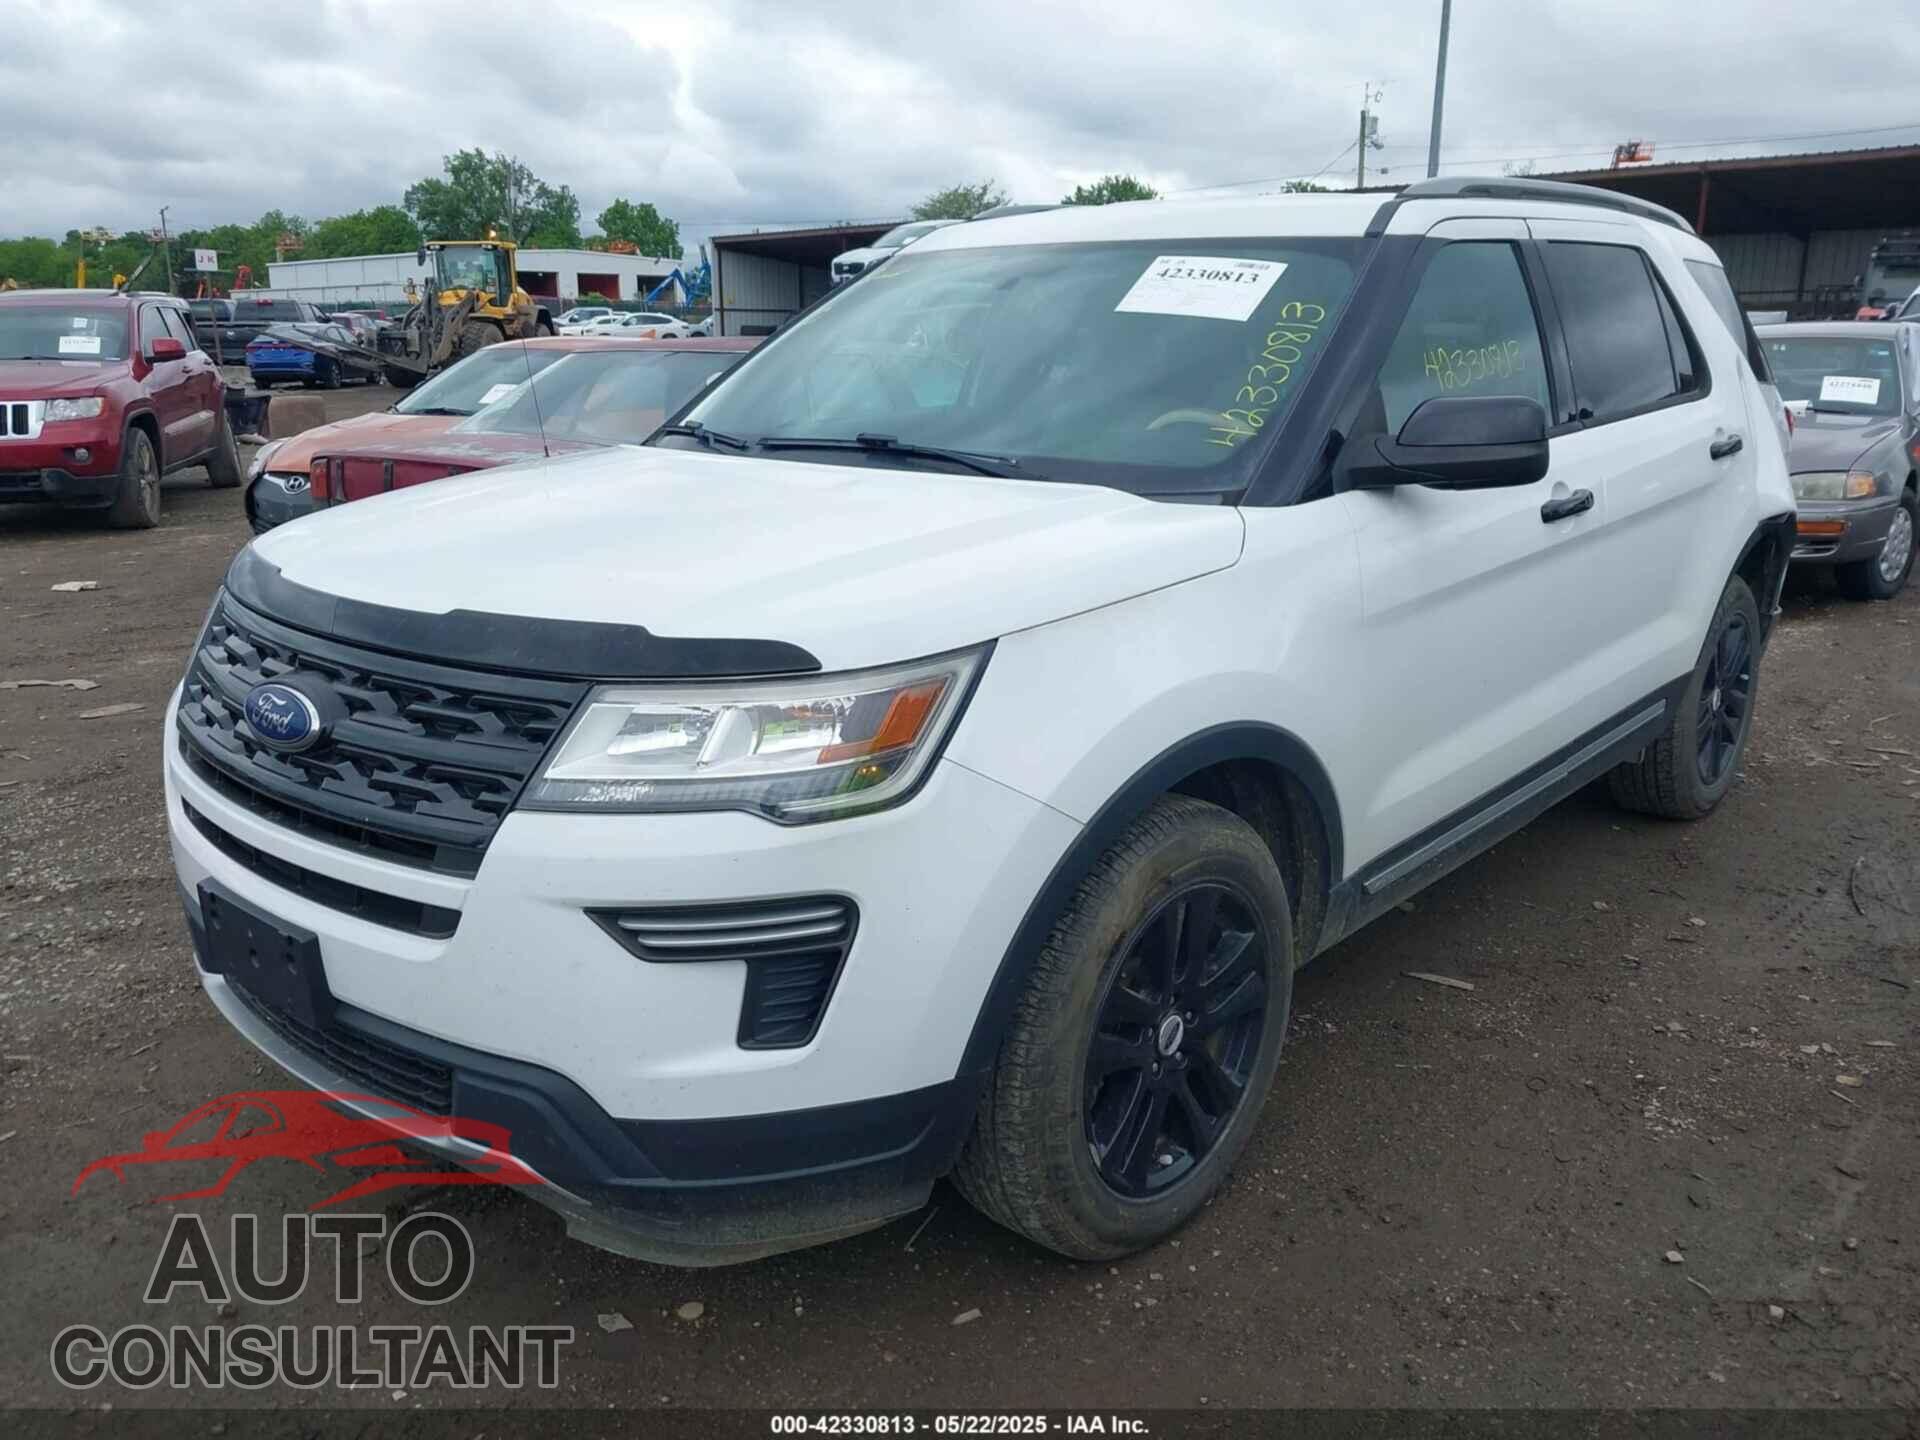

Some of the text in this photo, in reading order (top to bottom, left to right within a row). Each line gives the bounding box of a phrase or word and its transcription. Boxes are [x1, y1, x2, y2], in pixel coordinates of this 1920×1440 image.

[1156, 267, 1260, 284] 42330813
[1204, 301, 1326, 447] 42330813
[252, 692, 295, 734] Ford
